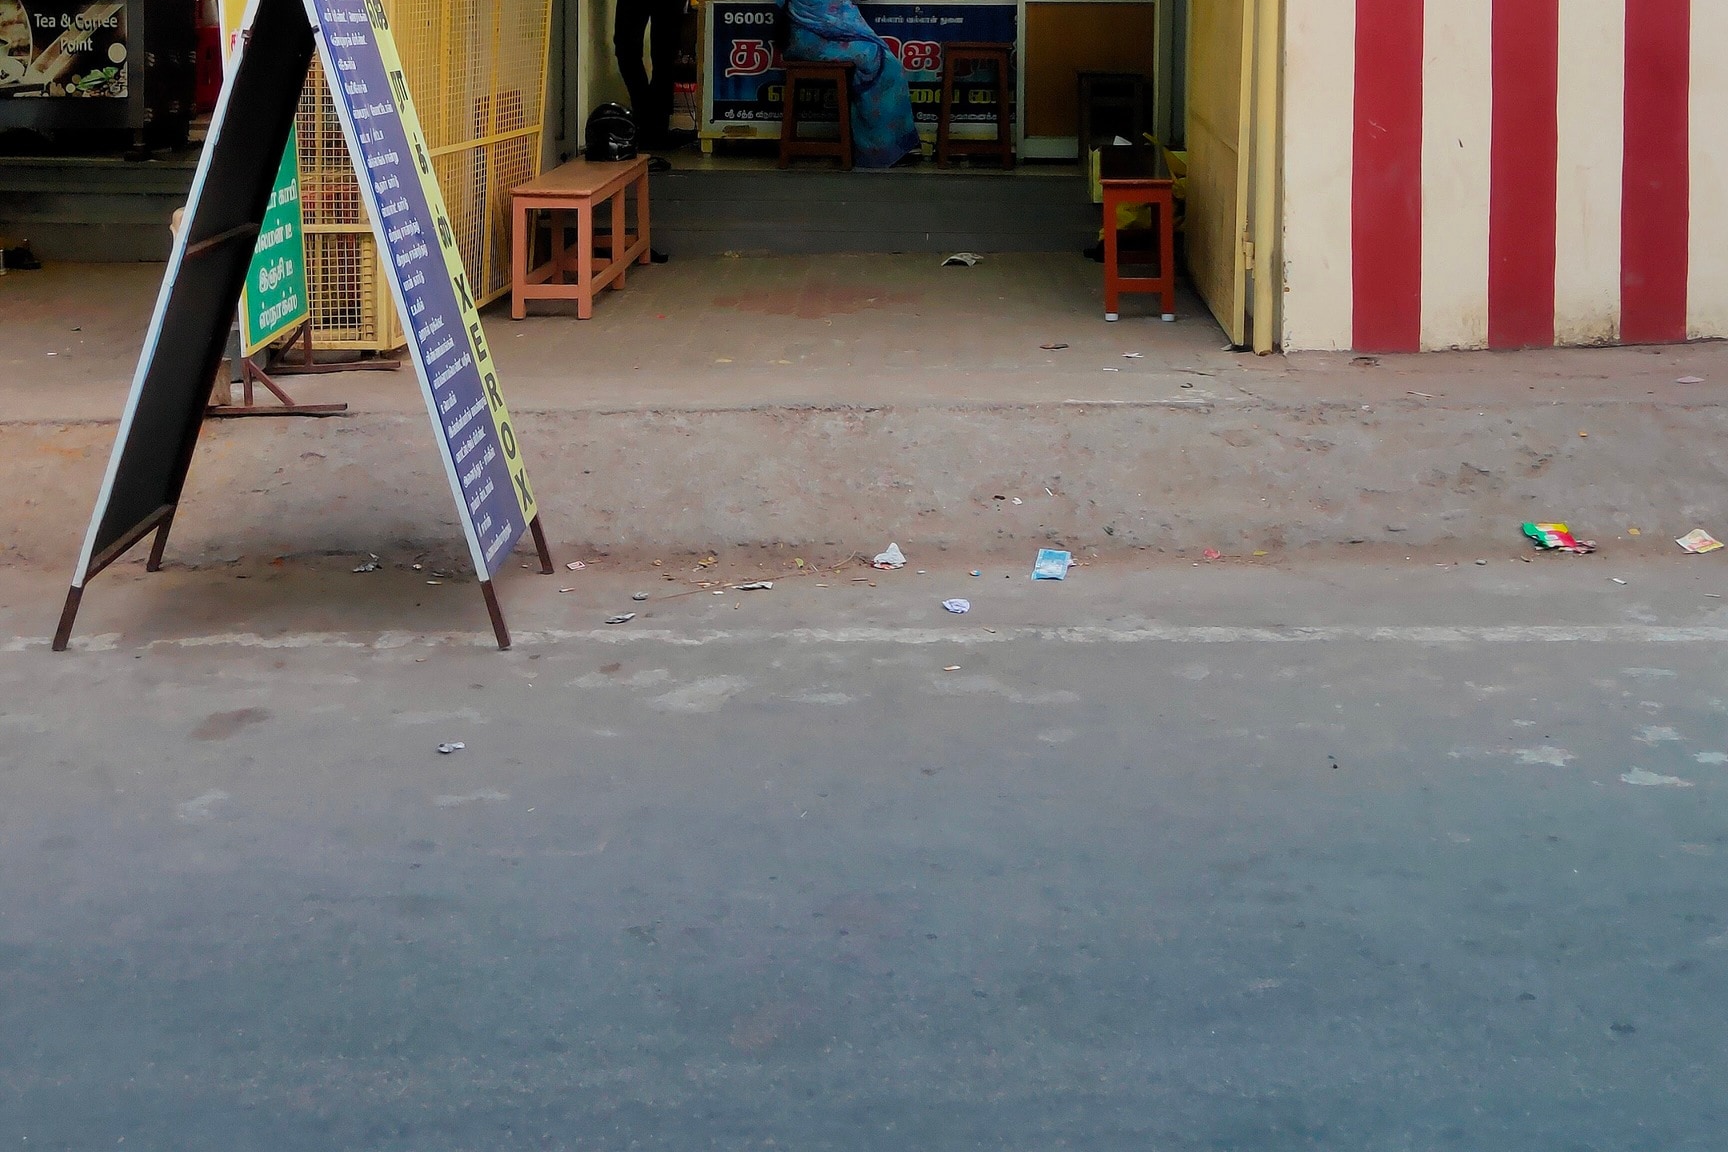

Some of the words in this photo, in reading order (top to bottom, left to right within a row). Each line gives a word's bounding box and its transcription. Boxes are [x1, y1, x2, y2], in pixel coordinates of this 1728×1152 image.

[34, 13, 56, 28] Tea
[60, 13, 71, 28] &
[724, 12, 774, 24] 96003
